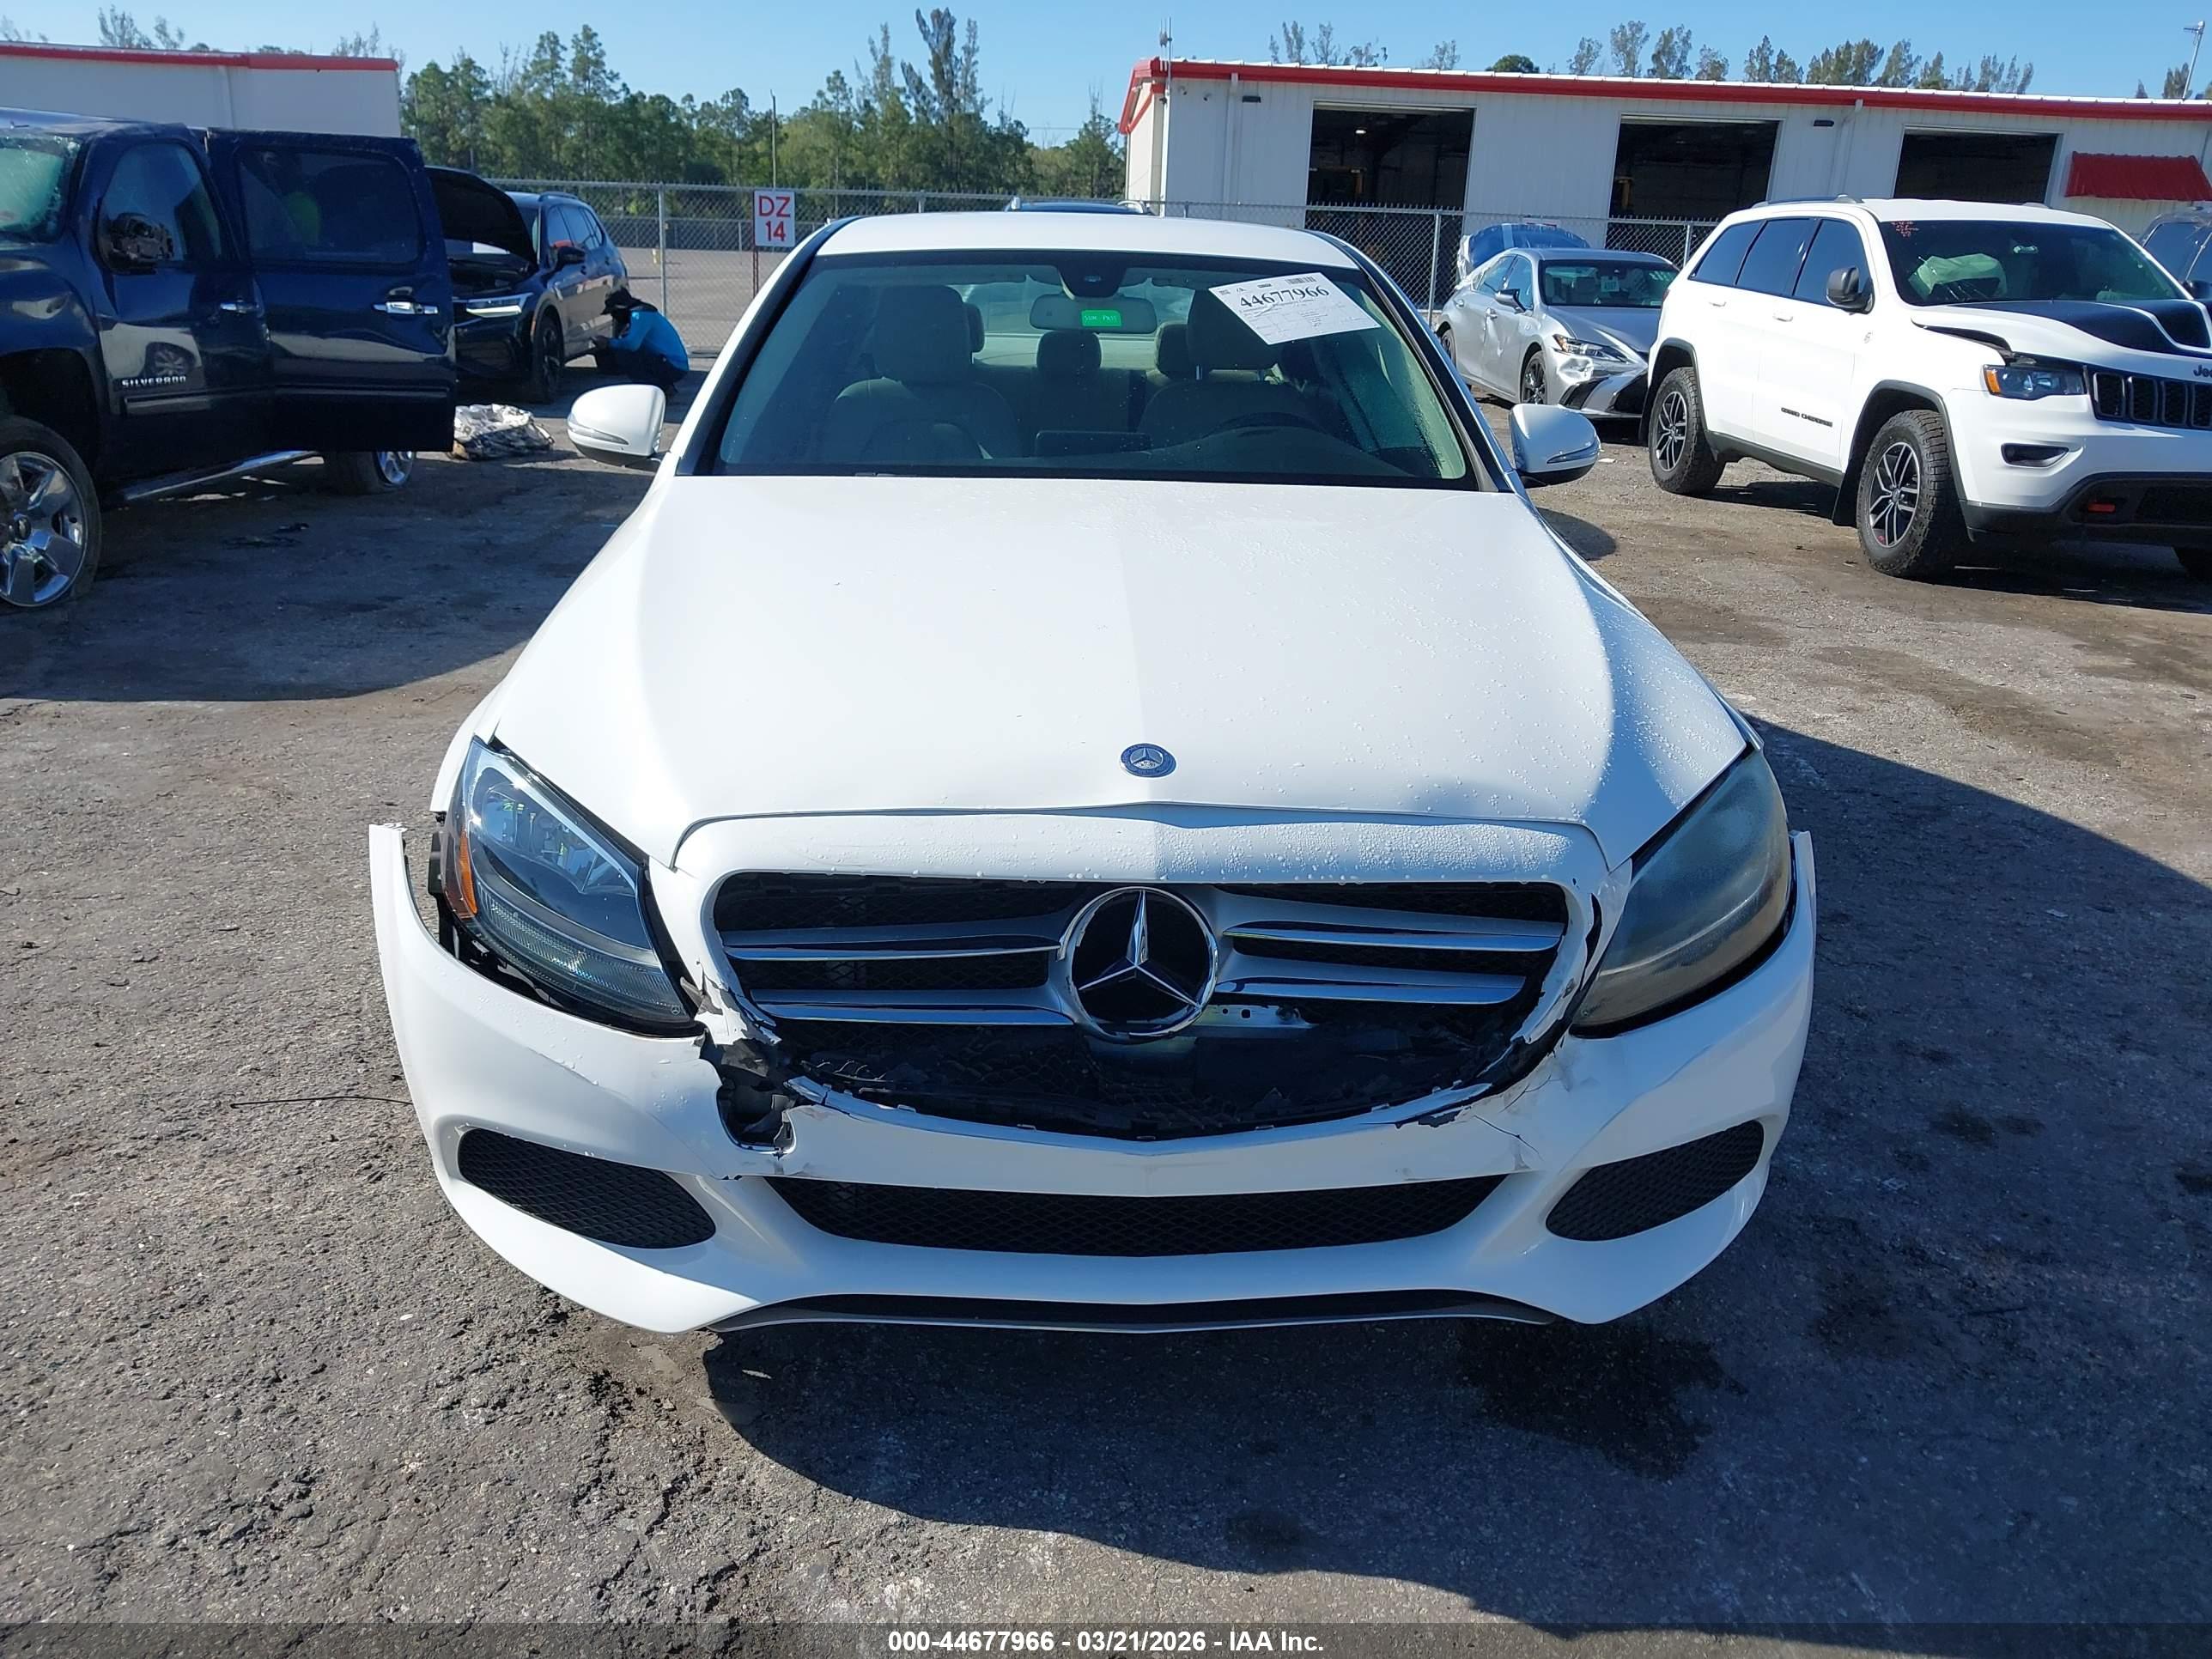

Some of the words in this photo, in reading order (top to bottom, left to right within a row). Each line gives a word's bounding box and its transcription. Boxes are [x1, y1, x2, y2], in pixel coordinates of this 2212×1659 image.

[758, 195, 791, 217] DZ
[765, 220, 787, 241] 14
[1240, 285, 1329, 308] 44677966
[121, 376, 186, 387] SILVERADO
[2193, 364, 2212, 378] Je
